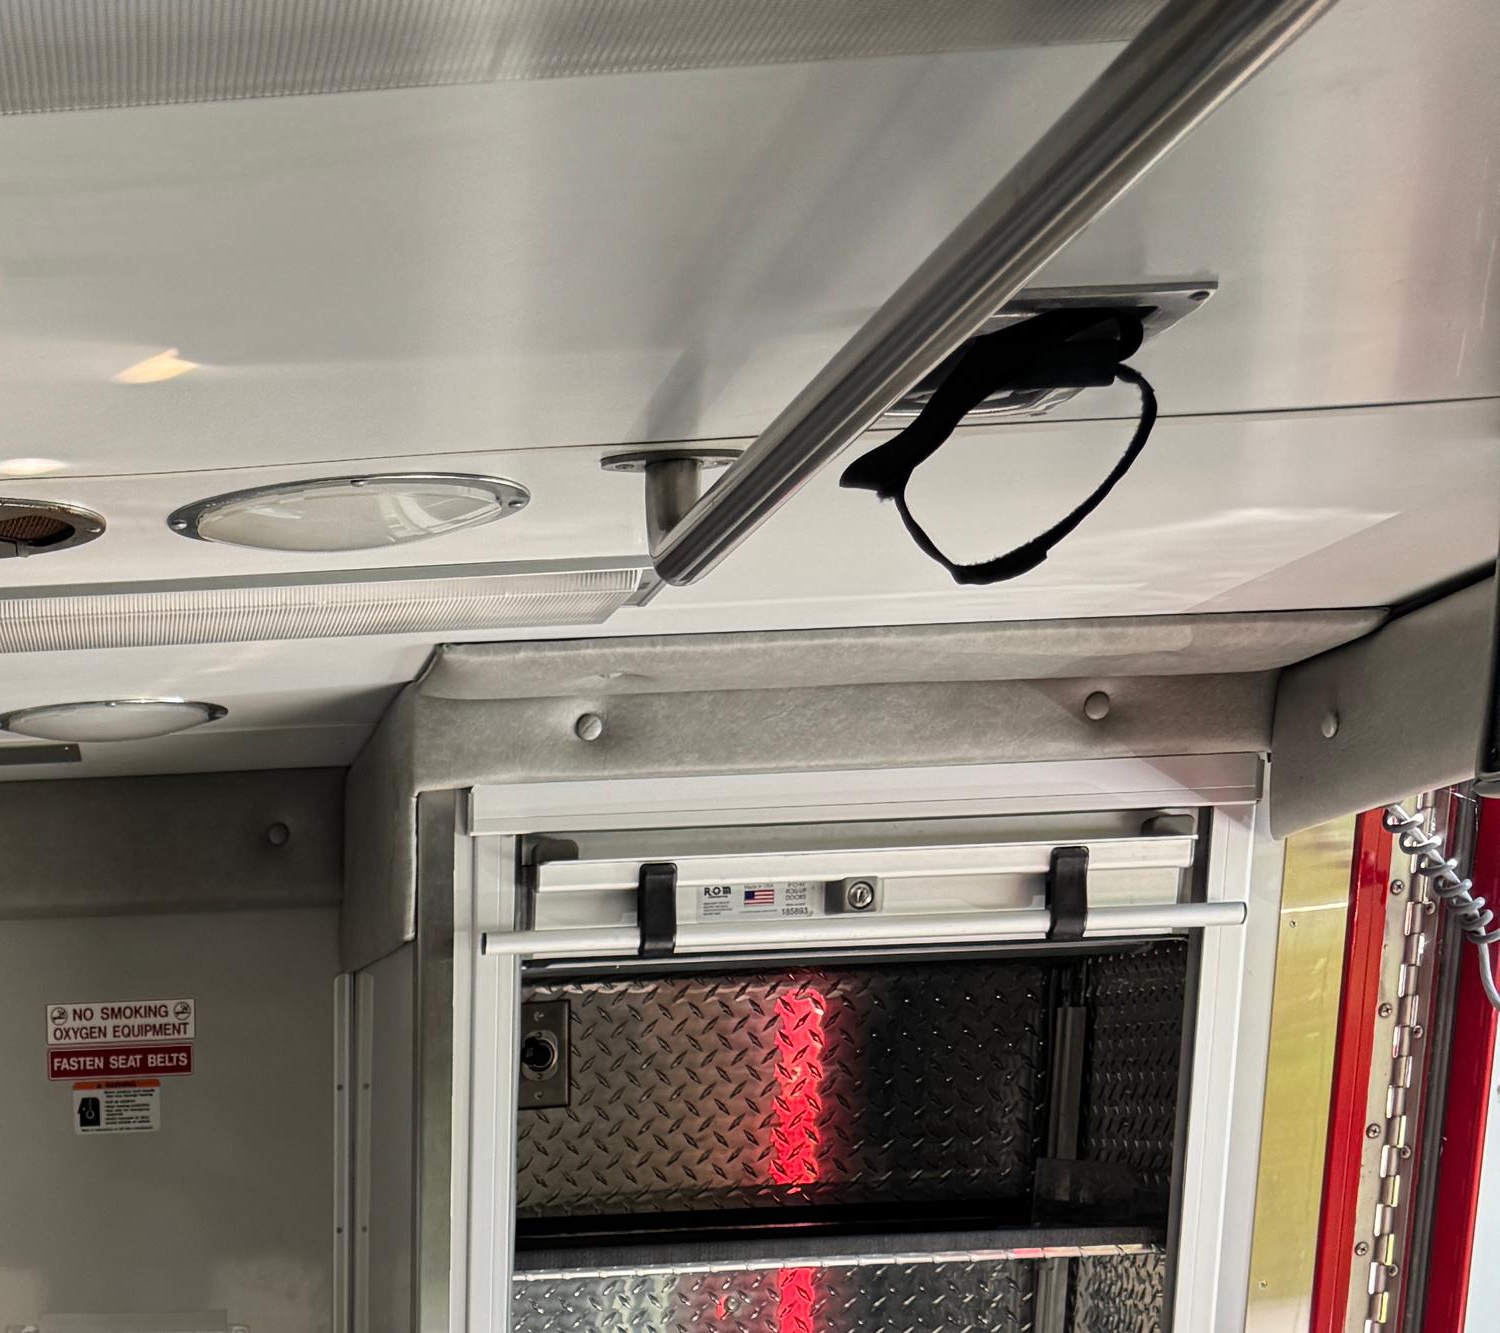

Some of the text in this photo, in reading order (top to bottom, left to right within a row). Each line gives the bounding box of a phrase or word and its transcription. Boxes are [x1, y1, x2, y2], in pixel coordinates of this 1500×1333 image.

[72, 1005, 169, 1021] NO SMOKING
[53, 1022, 189, 1041] OXYGEN EQUIPMENT
[53, 1053, 188, 1071] FASTEN SEAT BELTS
